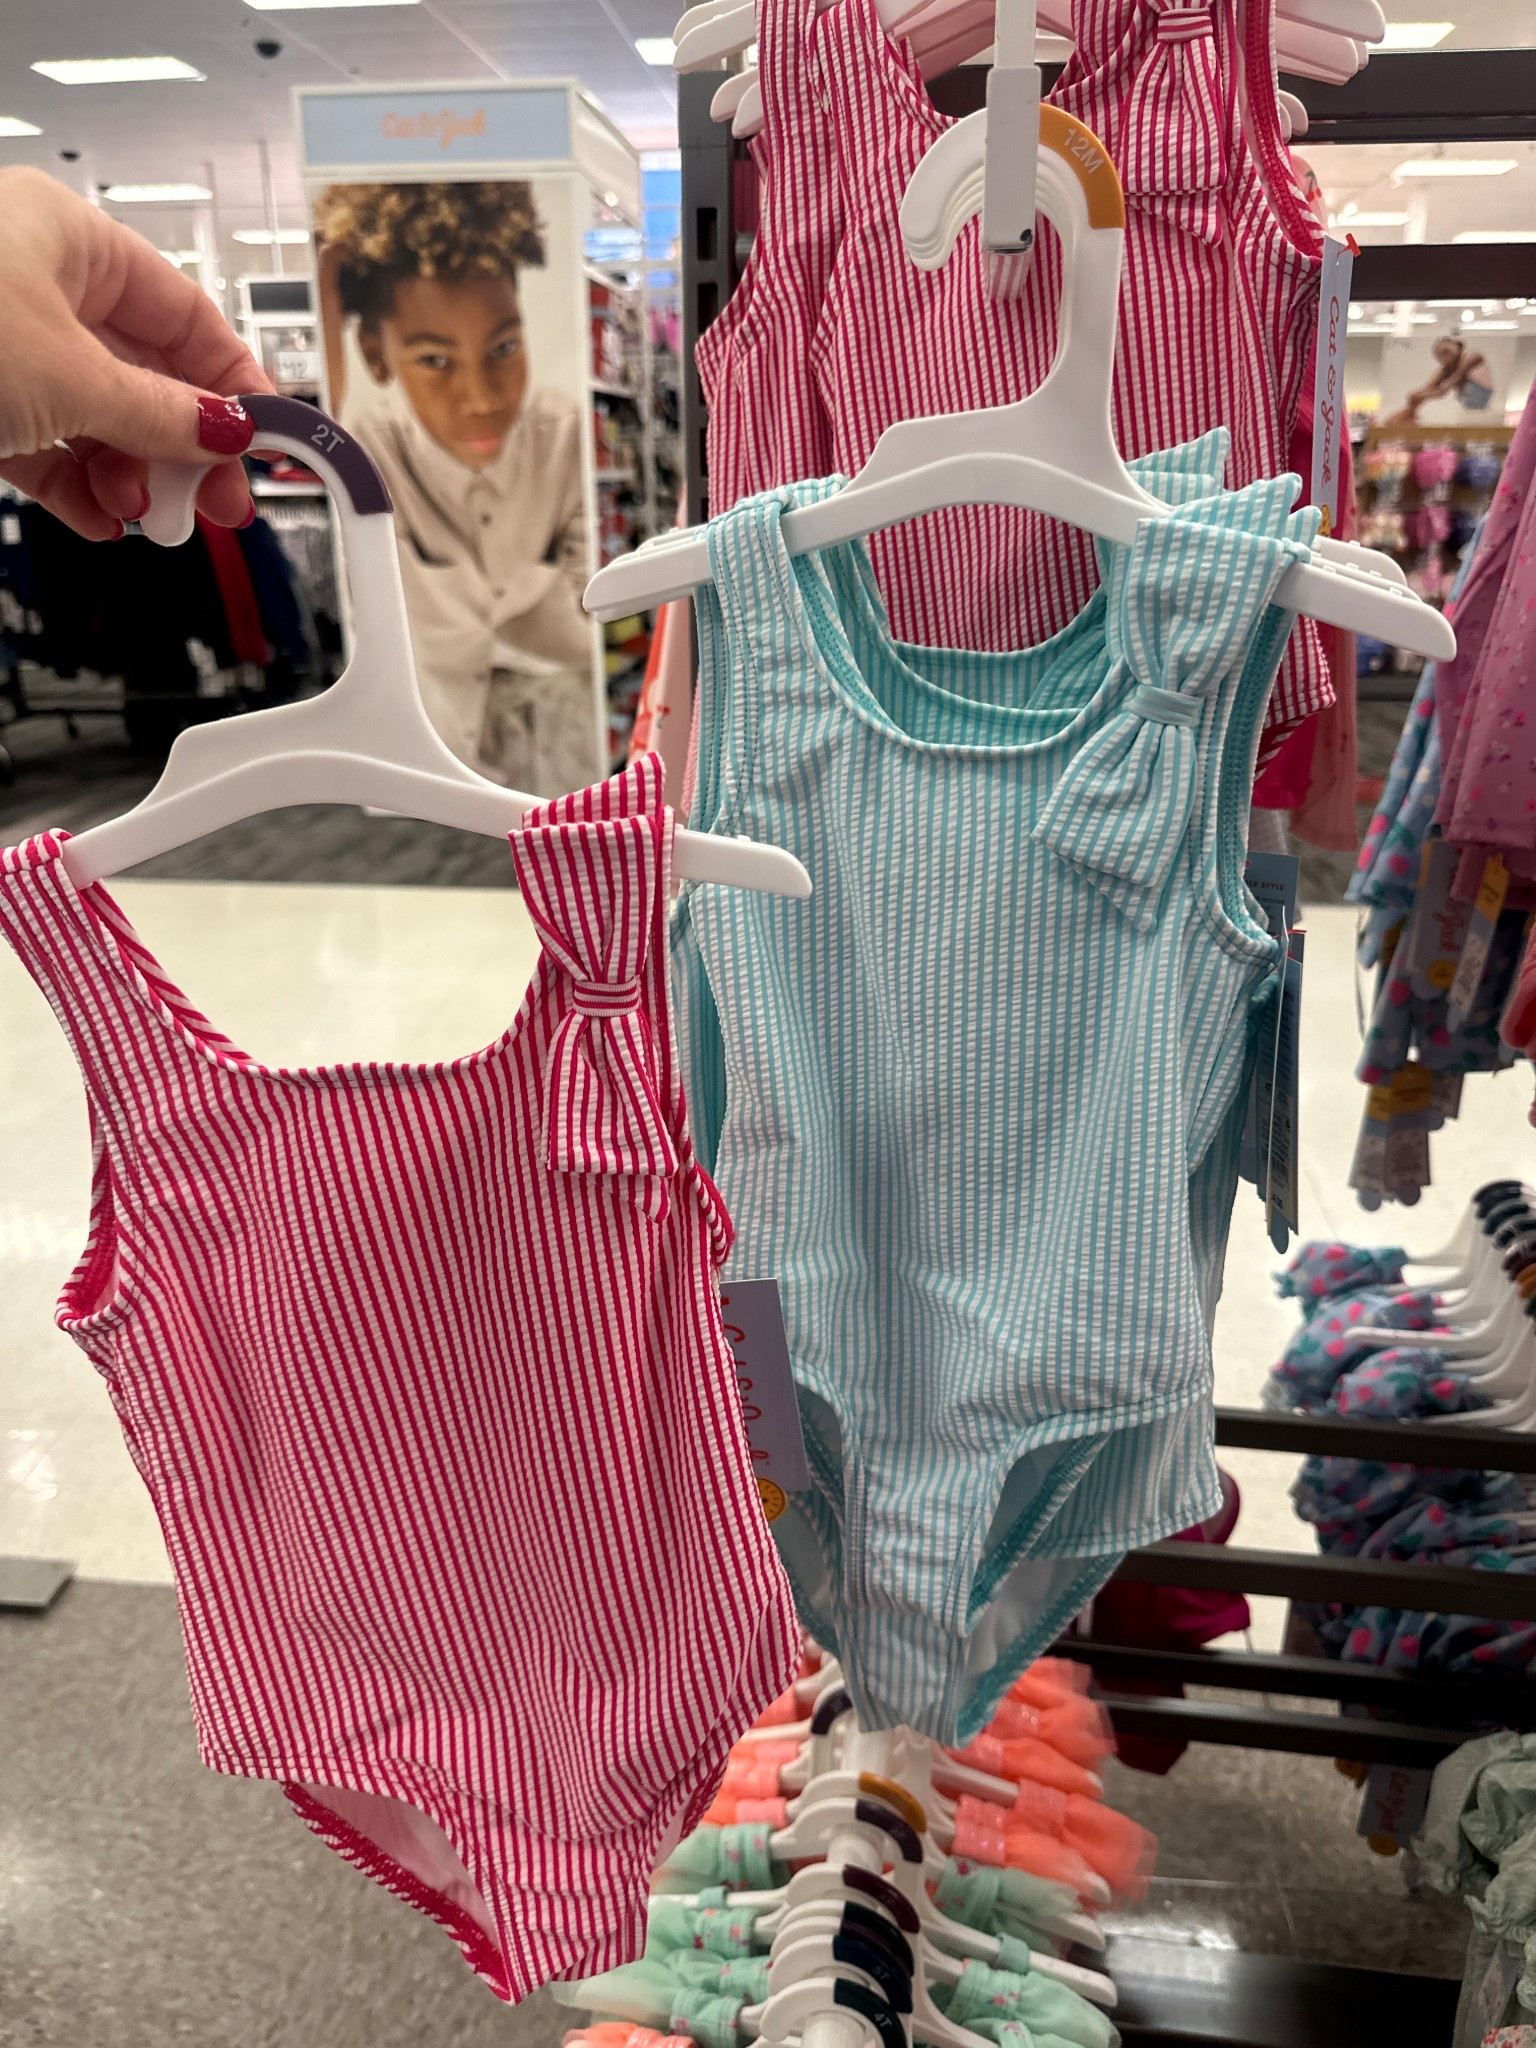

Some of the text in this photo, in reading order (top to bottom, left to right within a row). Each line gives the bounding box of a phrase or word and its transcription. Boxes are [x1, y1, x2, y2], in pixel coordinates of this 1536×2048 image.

[1064, 128, 1104, 174] 12M
[1328, 295, 1340, 358] Cat
[310, 423, 346, 453] 2T
[1320, 400, 1335, 488] Jack
[874, 2013, 893, 2028] 4T
